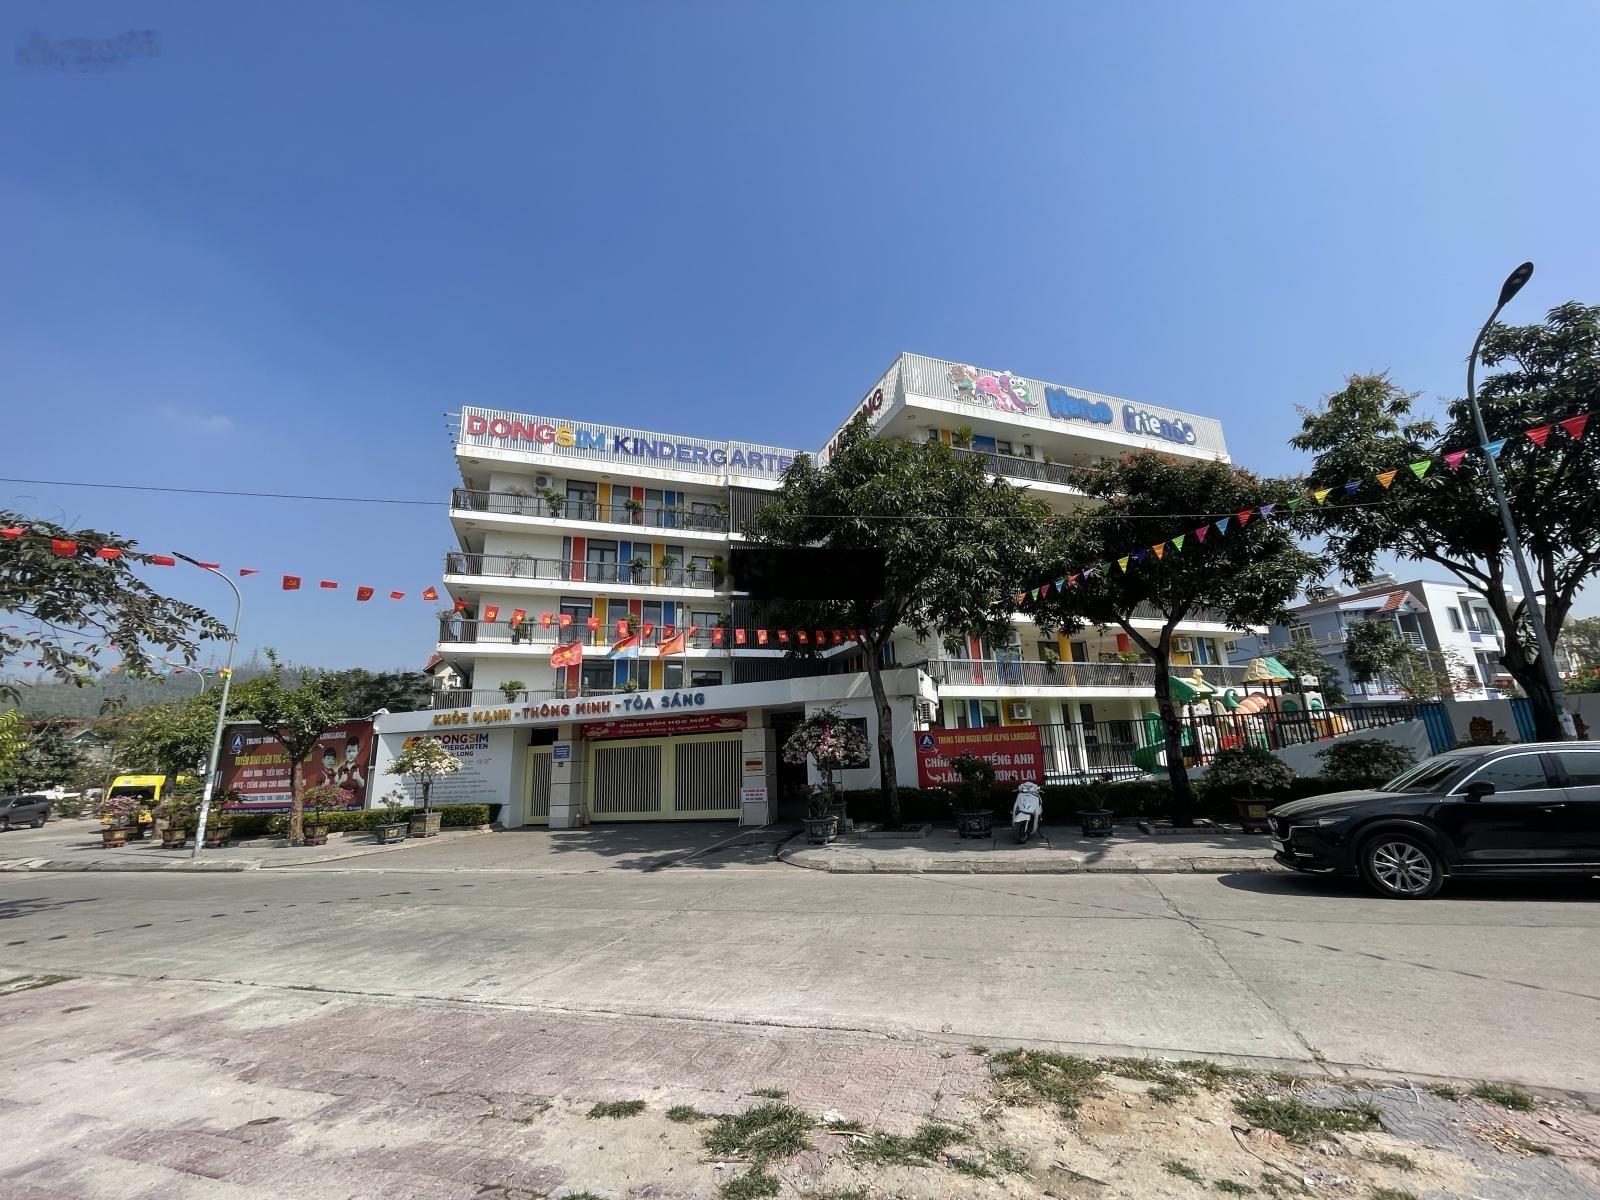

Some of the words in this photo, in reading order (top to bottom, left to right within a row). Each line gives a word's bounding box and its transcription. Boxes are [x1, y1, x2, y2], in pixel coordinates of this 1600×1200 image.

[466, 414, 606, 452] DONGSIM
[614, 435, 795, 474] KINDERGARTE
[433, 710, 469, 725] KHỎE
[473, 708, 512, 725] MẠNH
[522, 703, 570, 720] THÔNG
[576, 700, 612, 715] MINH
[624, 695, 655, 712] TÒA
[661, 692, 705, 708] SÁNG
[1014, 753, 1035, 765] ANH
[1020, 769, 1036, 781] LAI
